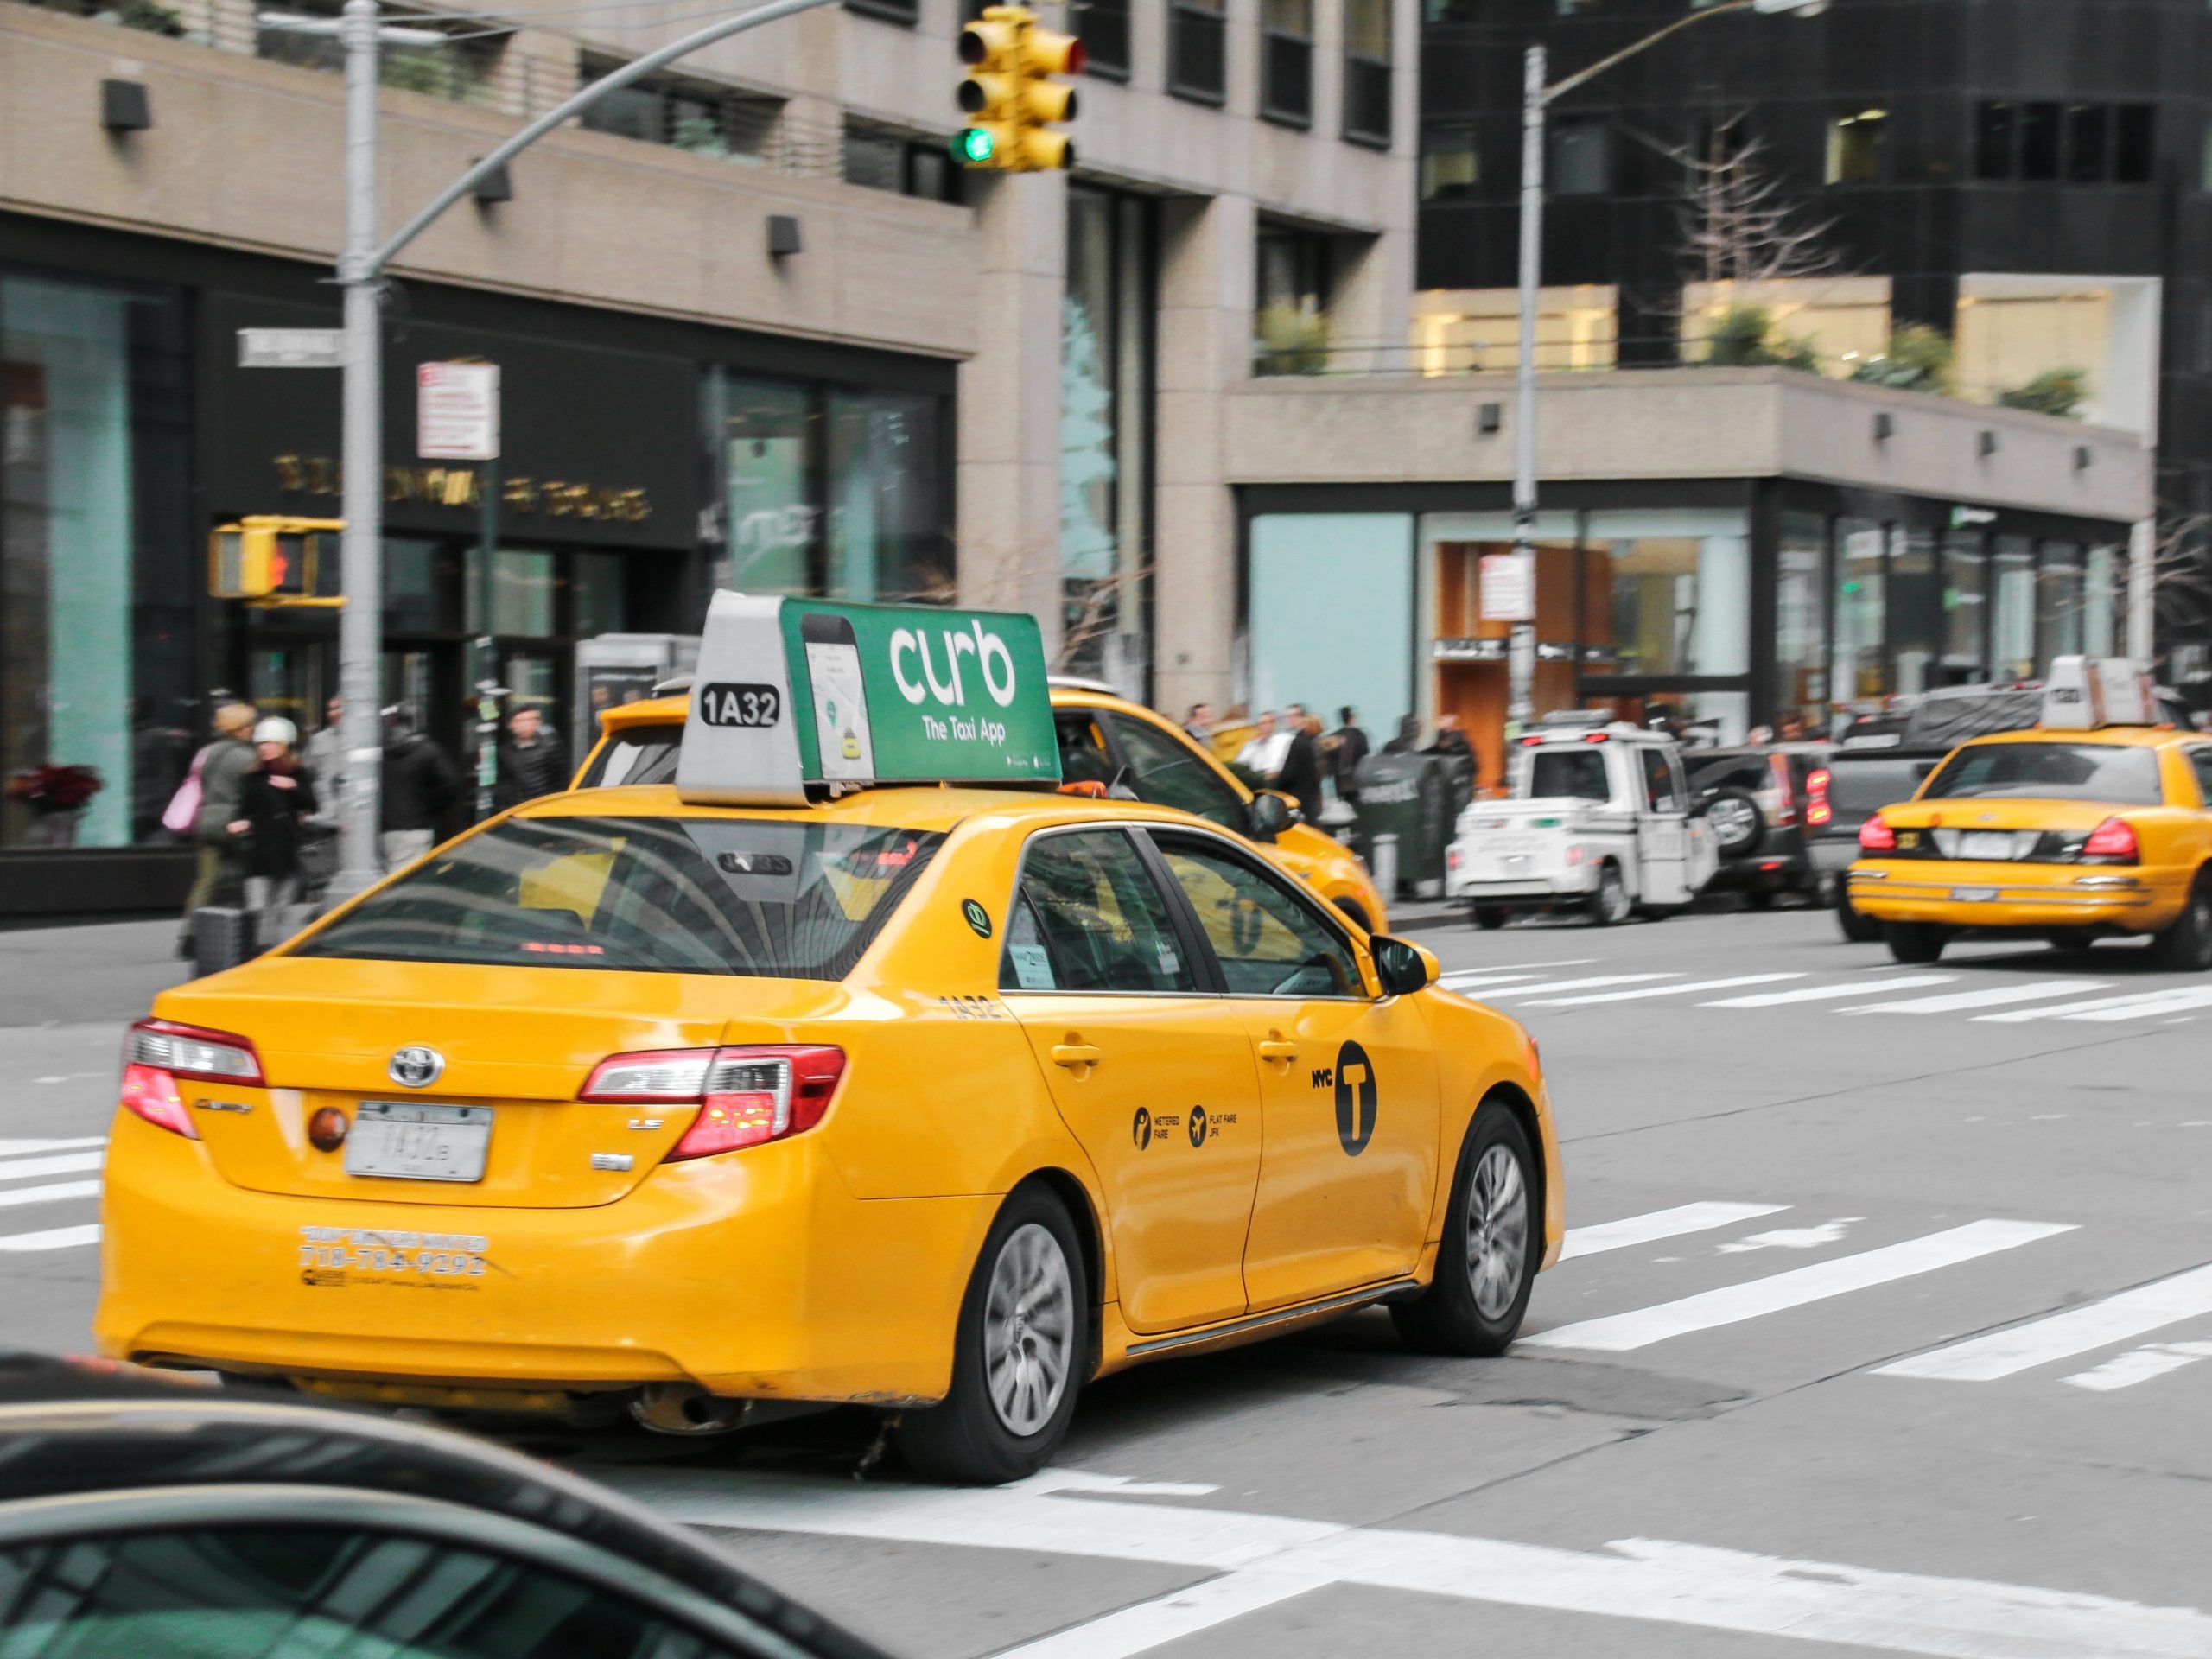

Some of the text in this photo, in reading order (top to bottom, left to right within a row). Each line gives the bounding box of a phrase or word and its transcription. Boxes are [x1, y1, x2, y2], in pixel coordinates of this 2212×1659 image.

[890, 619, 1016, 708] curb
[703, 690, 777, 726] 1A32
[921, 715, 1006, 747] The Taxi App
[1312, 1068, 1333, 1088] NYC
[1154, 1116, 1179, 1126] METERED
[1210, 1114, 1236, 1124] FLAT FARE
[1154, 1129, 1168, 1139] FARE
[1210, 1128, 1219, 1137] JFK
